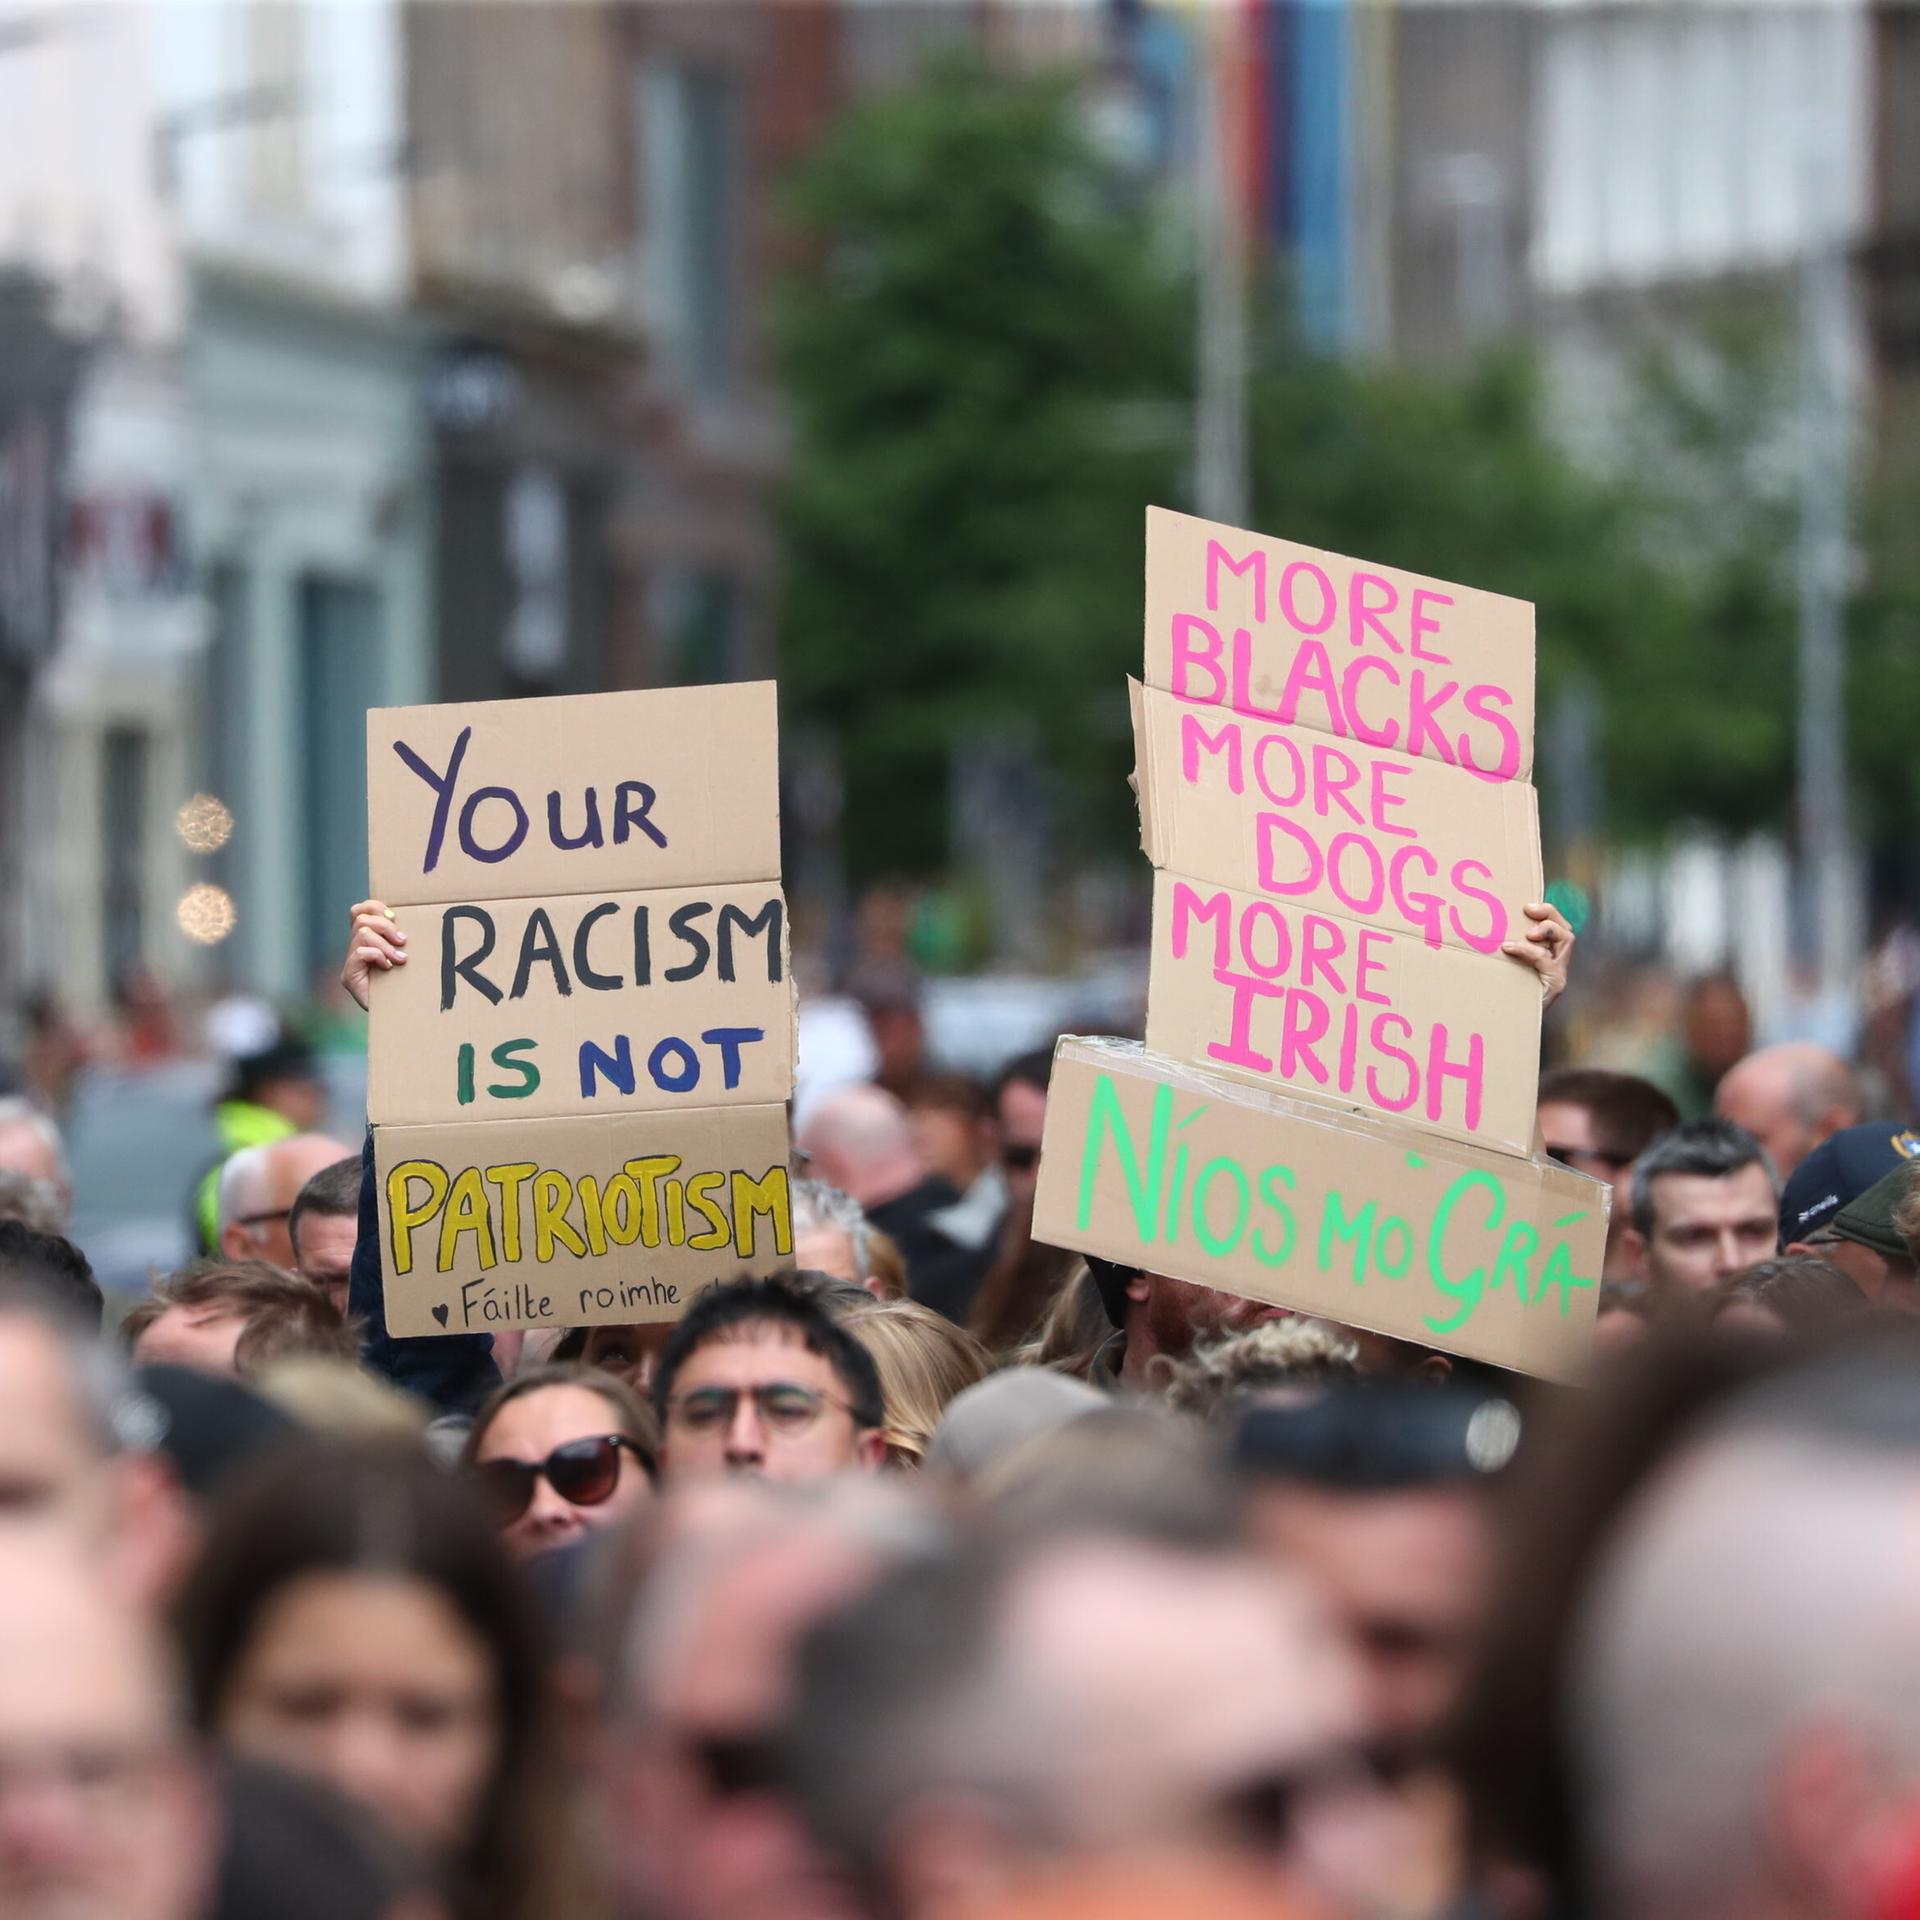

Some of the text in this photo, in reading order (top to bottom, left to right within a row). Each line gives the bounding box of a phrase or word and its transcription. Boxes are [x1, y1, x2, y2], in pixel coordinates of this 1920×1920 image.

[1205, 539, 1456, 665] MORE
[1170, 612, 1521, 784] BLACKS
[392, 726, 668, 874] YOUR
[1181, 714, 1419, 838] MORE
[1171, 881, 1395, 1006] MORE
[1256, 811, 1509, 955] DOGS
[440, 898, 784, 1013] RACISM
[457, 1027, 765, 1106] IS NOT
[1206, 967, 1485, 1131] IRISH
[386, 1154, 794, 1276] PATRIOTISM
[460, 1277, 554, 1328] Fáilte
[578, 1275, 682, 1314] roimhe
